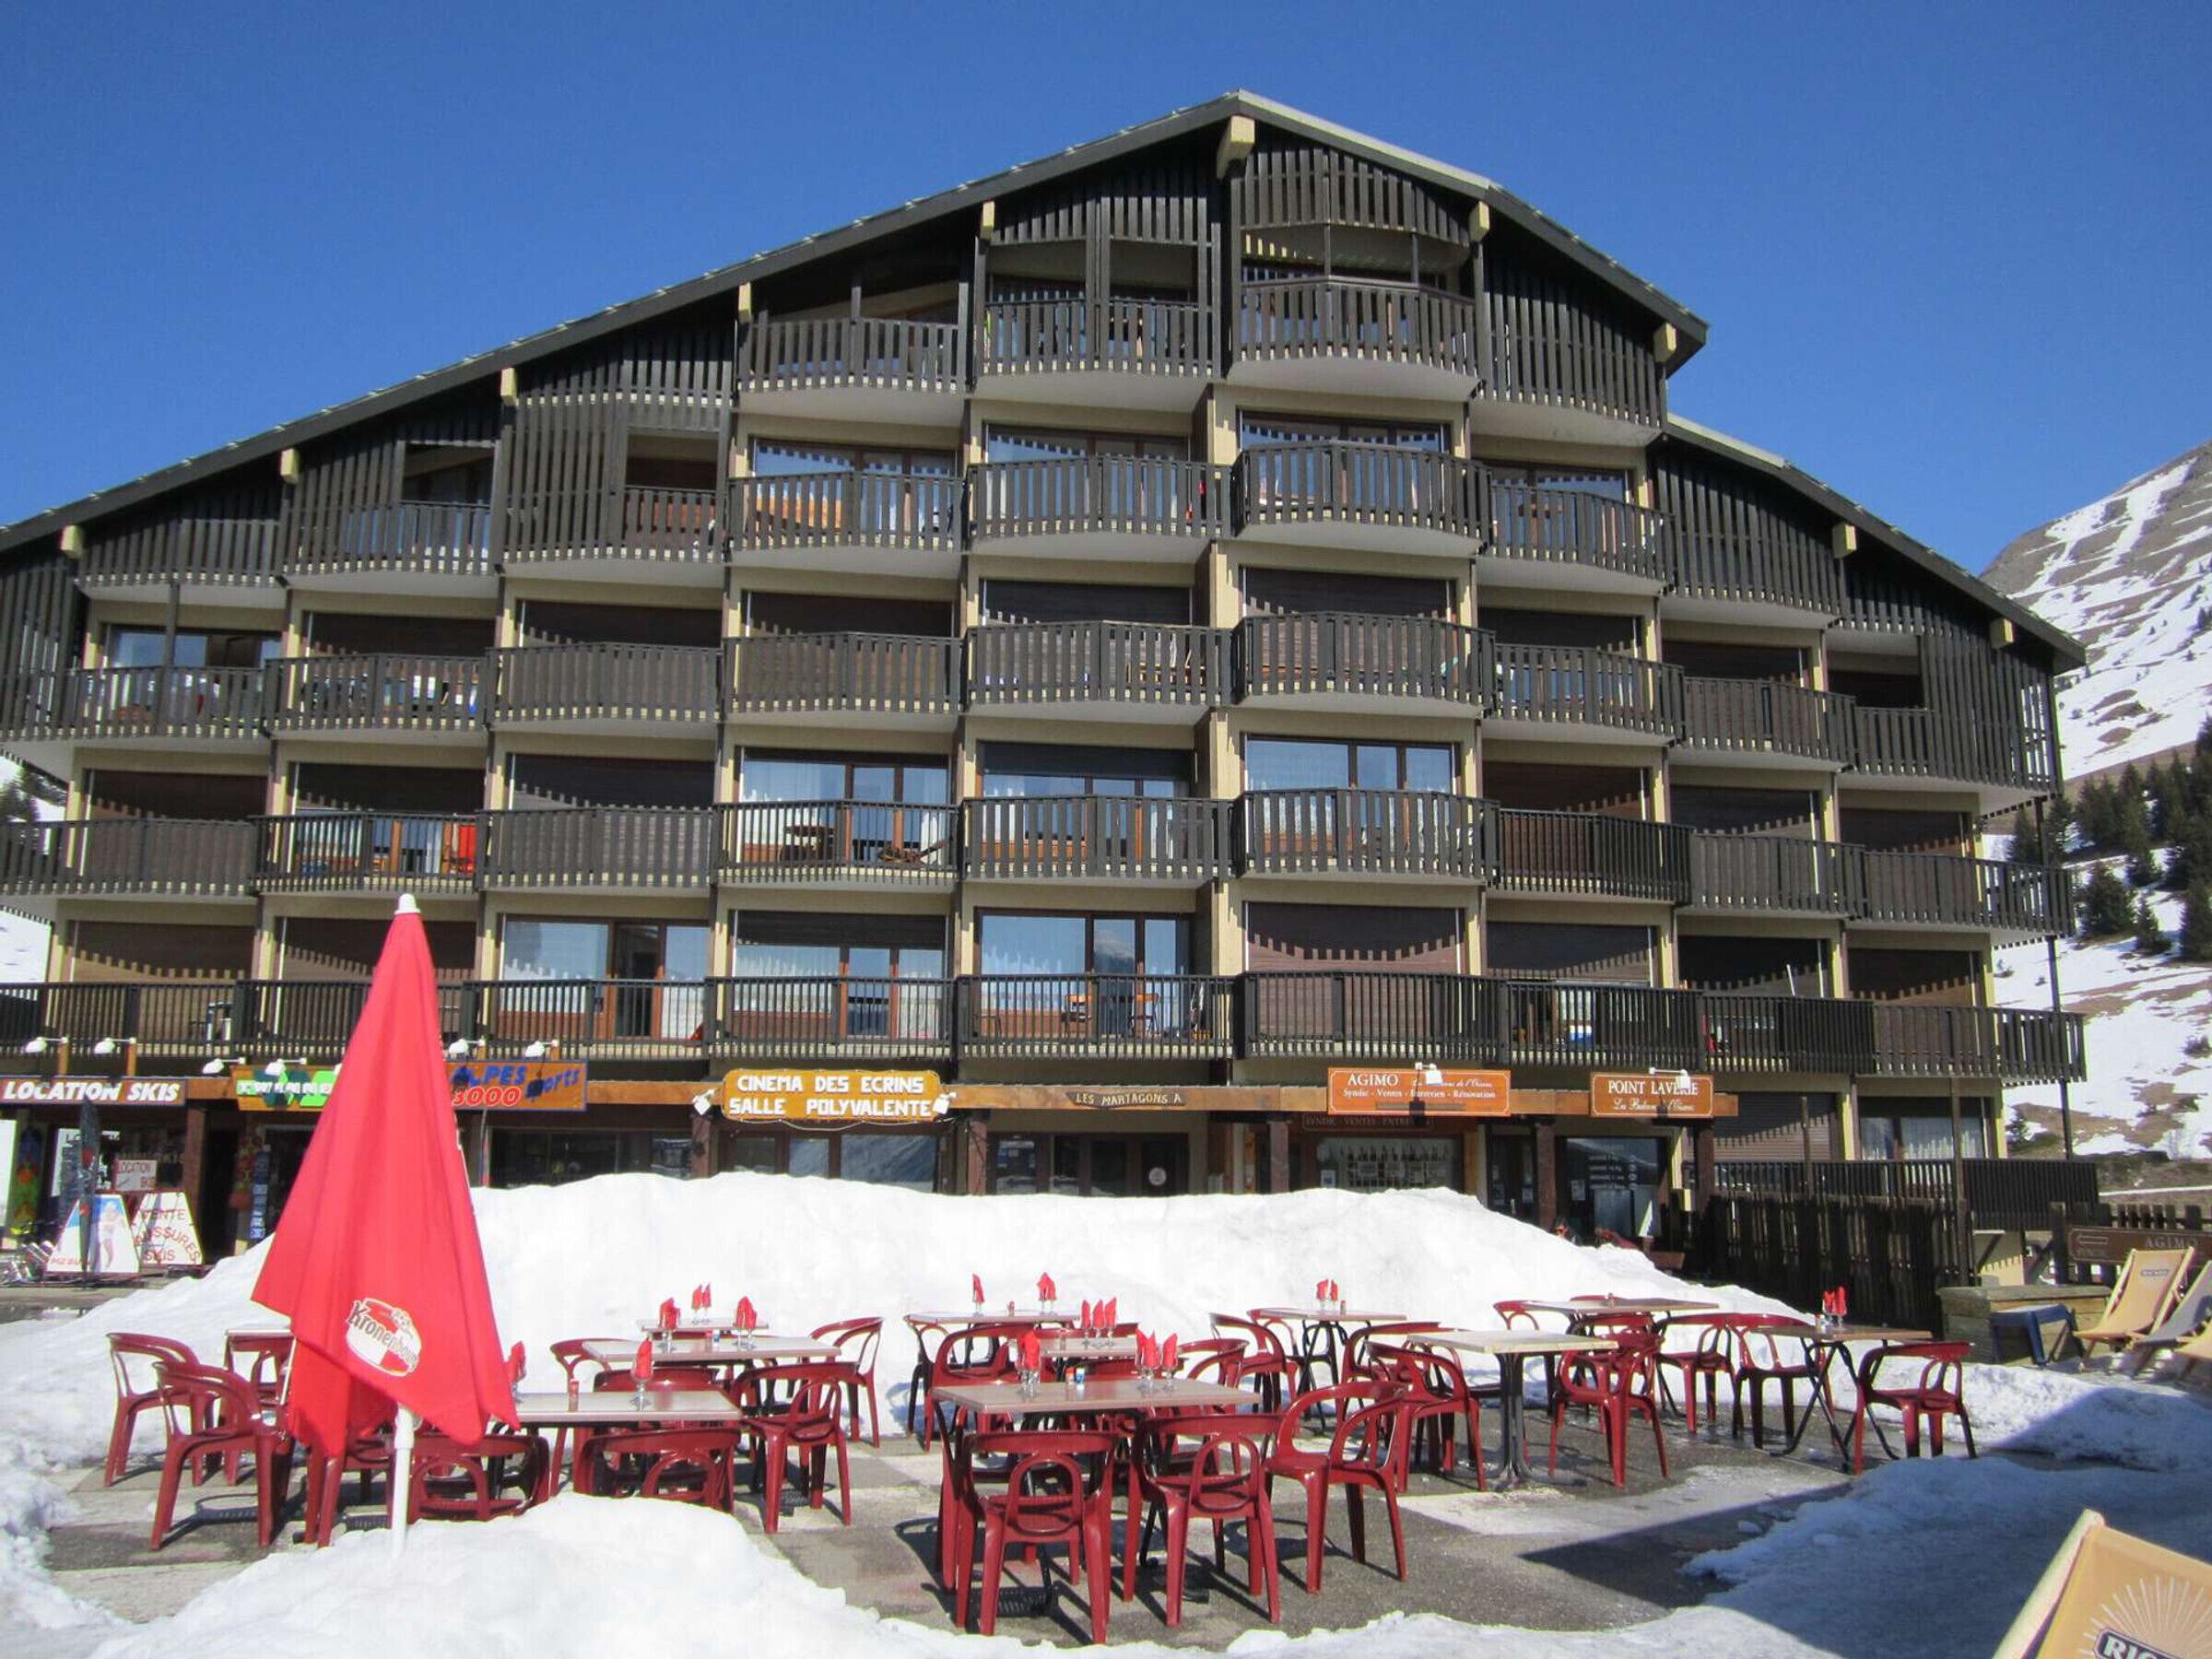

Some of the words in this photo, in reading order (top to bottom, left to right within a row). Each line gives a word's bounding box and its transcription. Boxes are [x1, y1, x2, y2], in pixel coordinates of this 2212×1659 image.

[737, 1076, 803, 1092] CINEMA
[815, 1077, 849, 1093] DES
[860, 1077, 924, 1094] ECRINS
[1347, 1073, 1399, 1087] AGIMO
[1607, 1080, 1645, 1094] POINT
[3, 1081, 121, 1100] LOCATION
[127, 1082, 181, 1101] SKIS
[452, 1086, 522, 1106] 3000
[1076, 1092, 1095, 1104] LES
[1101, 1093, 1168, 1105] MARTAGONS
[1173, 1093, 1181, 1102] A
[729, 1099, 786, 1114] SALLE
[806, 1100, 931, 1115] POLYVALENTE
